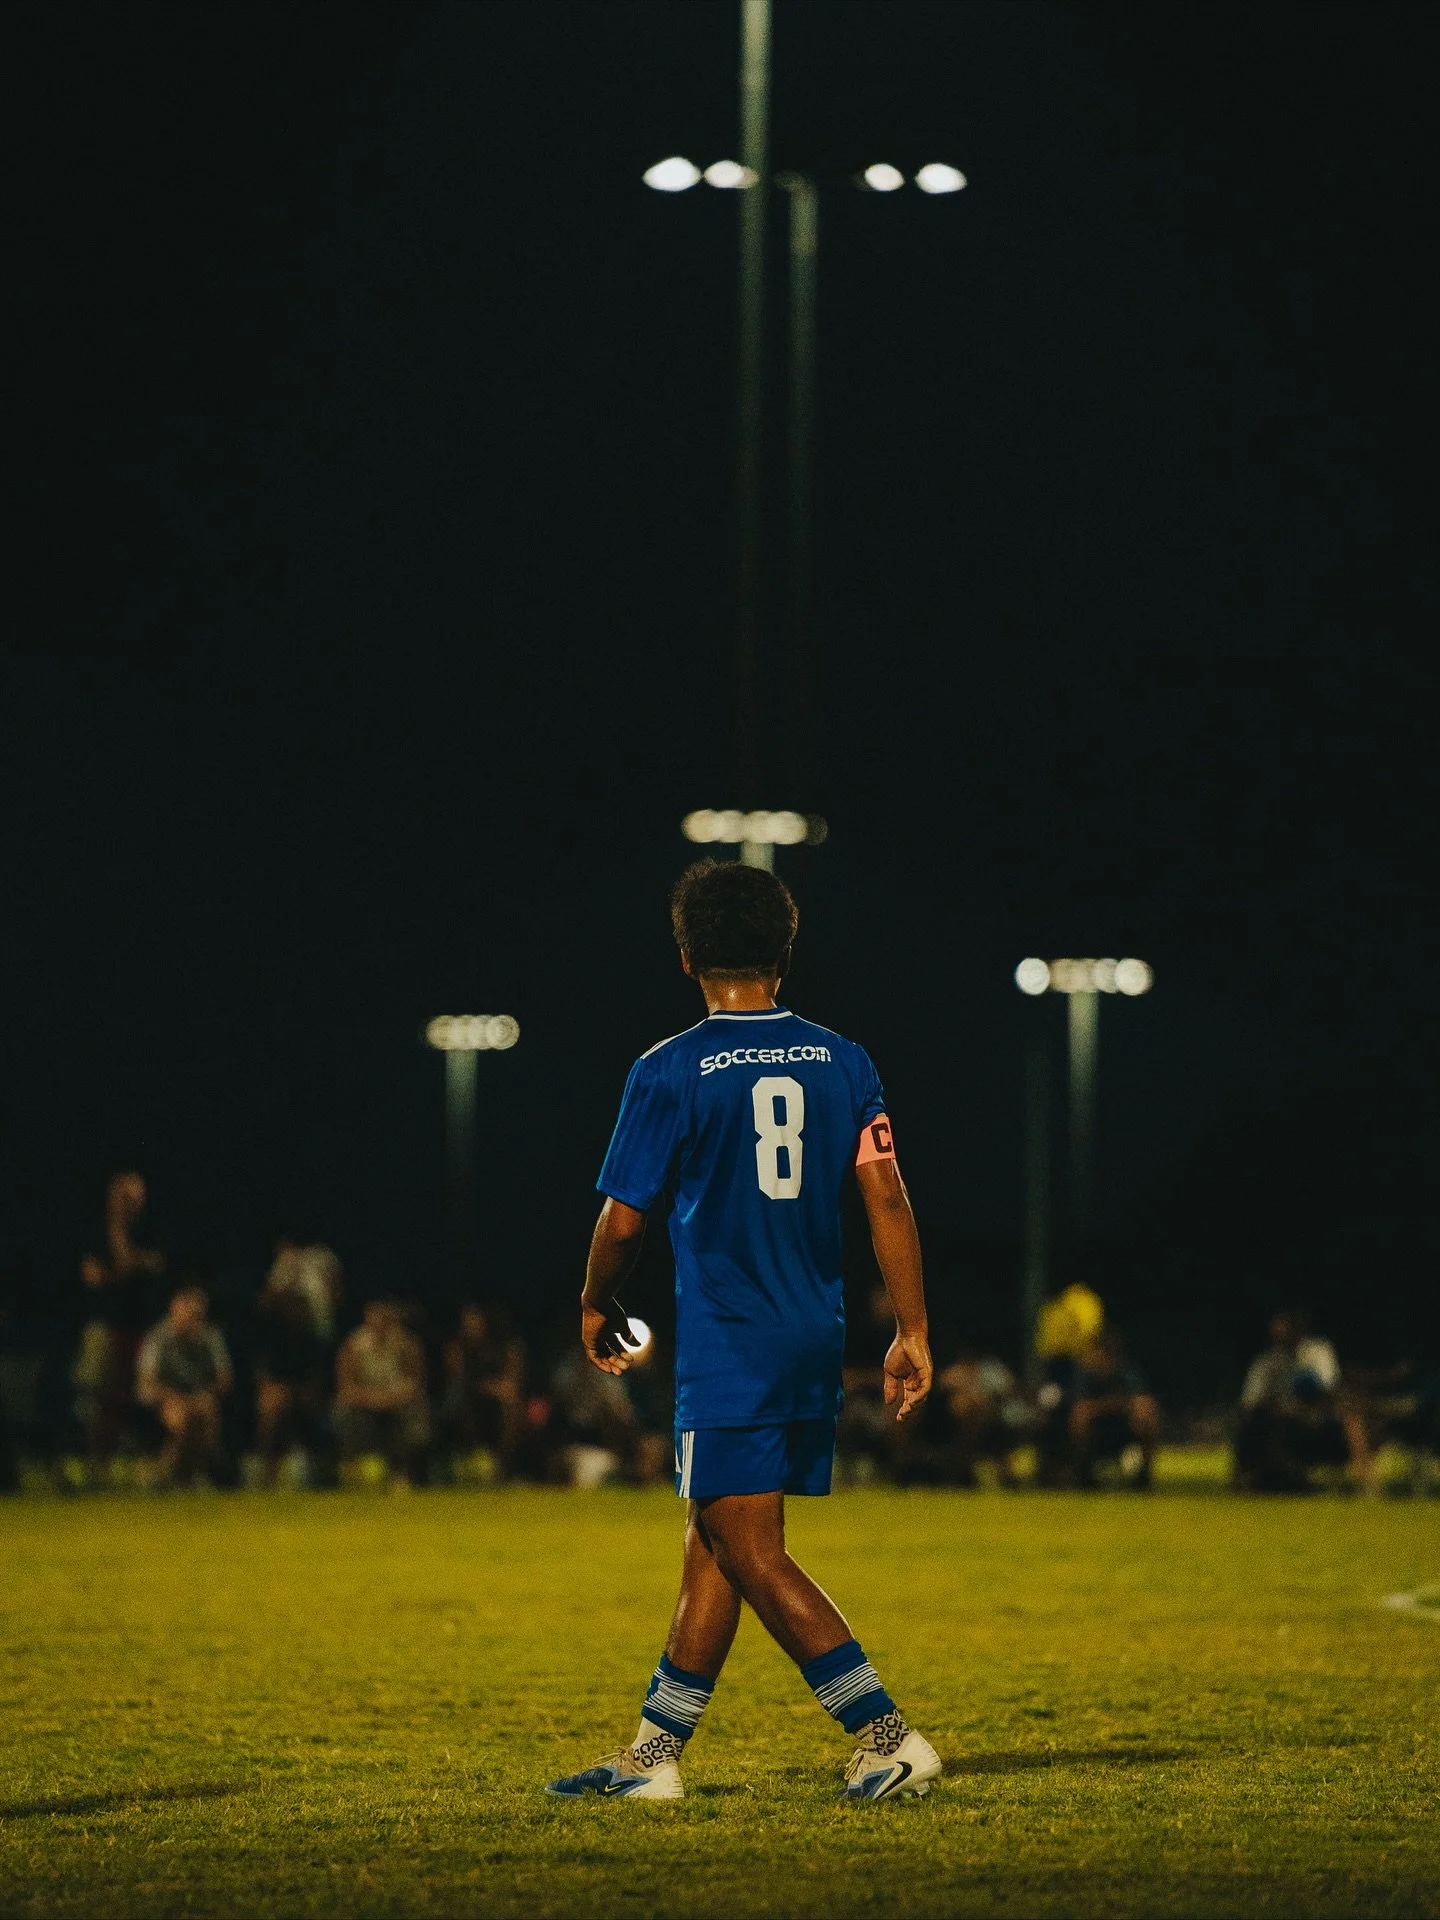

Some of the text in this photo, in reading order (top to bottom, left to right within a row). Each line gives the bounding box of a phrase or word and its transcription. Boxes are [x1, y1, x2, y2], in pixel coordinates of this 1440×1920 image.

[700, 1045, 832, 1076] SOCCER.COM
[752, 1076, 804, 1199] 8
[870, 1122, 892, 1153] C
